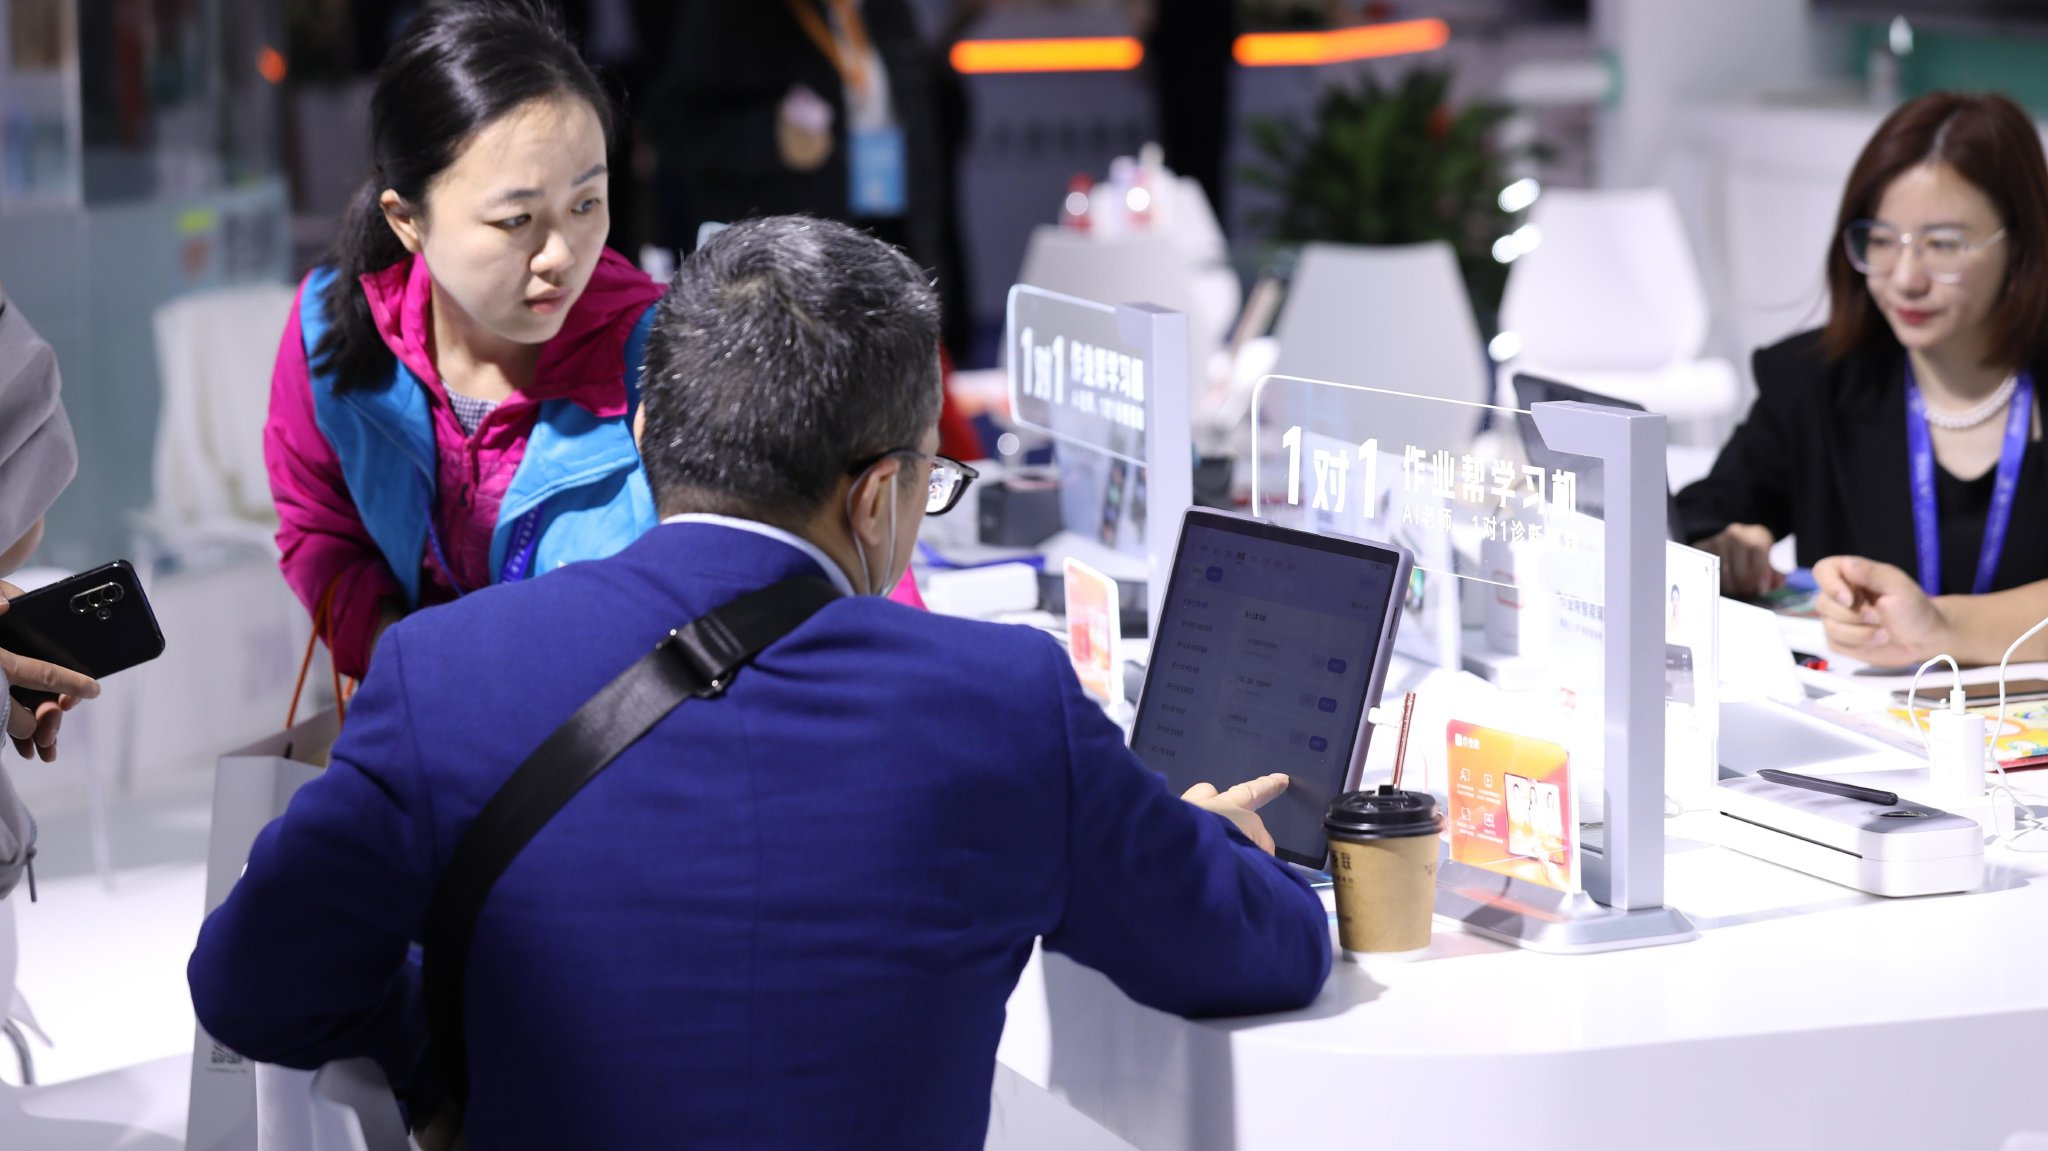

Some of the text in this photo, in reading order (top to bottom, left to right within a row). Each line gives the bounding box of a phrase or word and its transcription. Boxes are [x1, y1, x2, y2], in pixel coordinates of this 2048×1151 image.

[1282, 426, 1378, 519] 1对1
[1402, 444, 1577, 515] 作业帮学习机
[1403, 504, 1453, 532] AI老师
